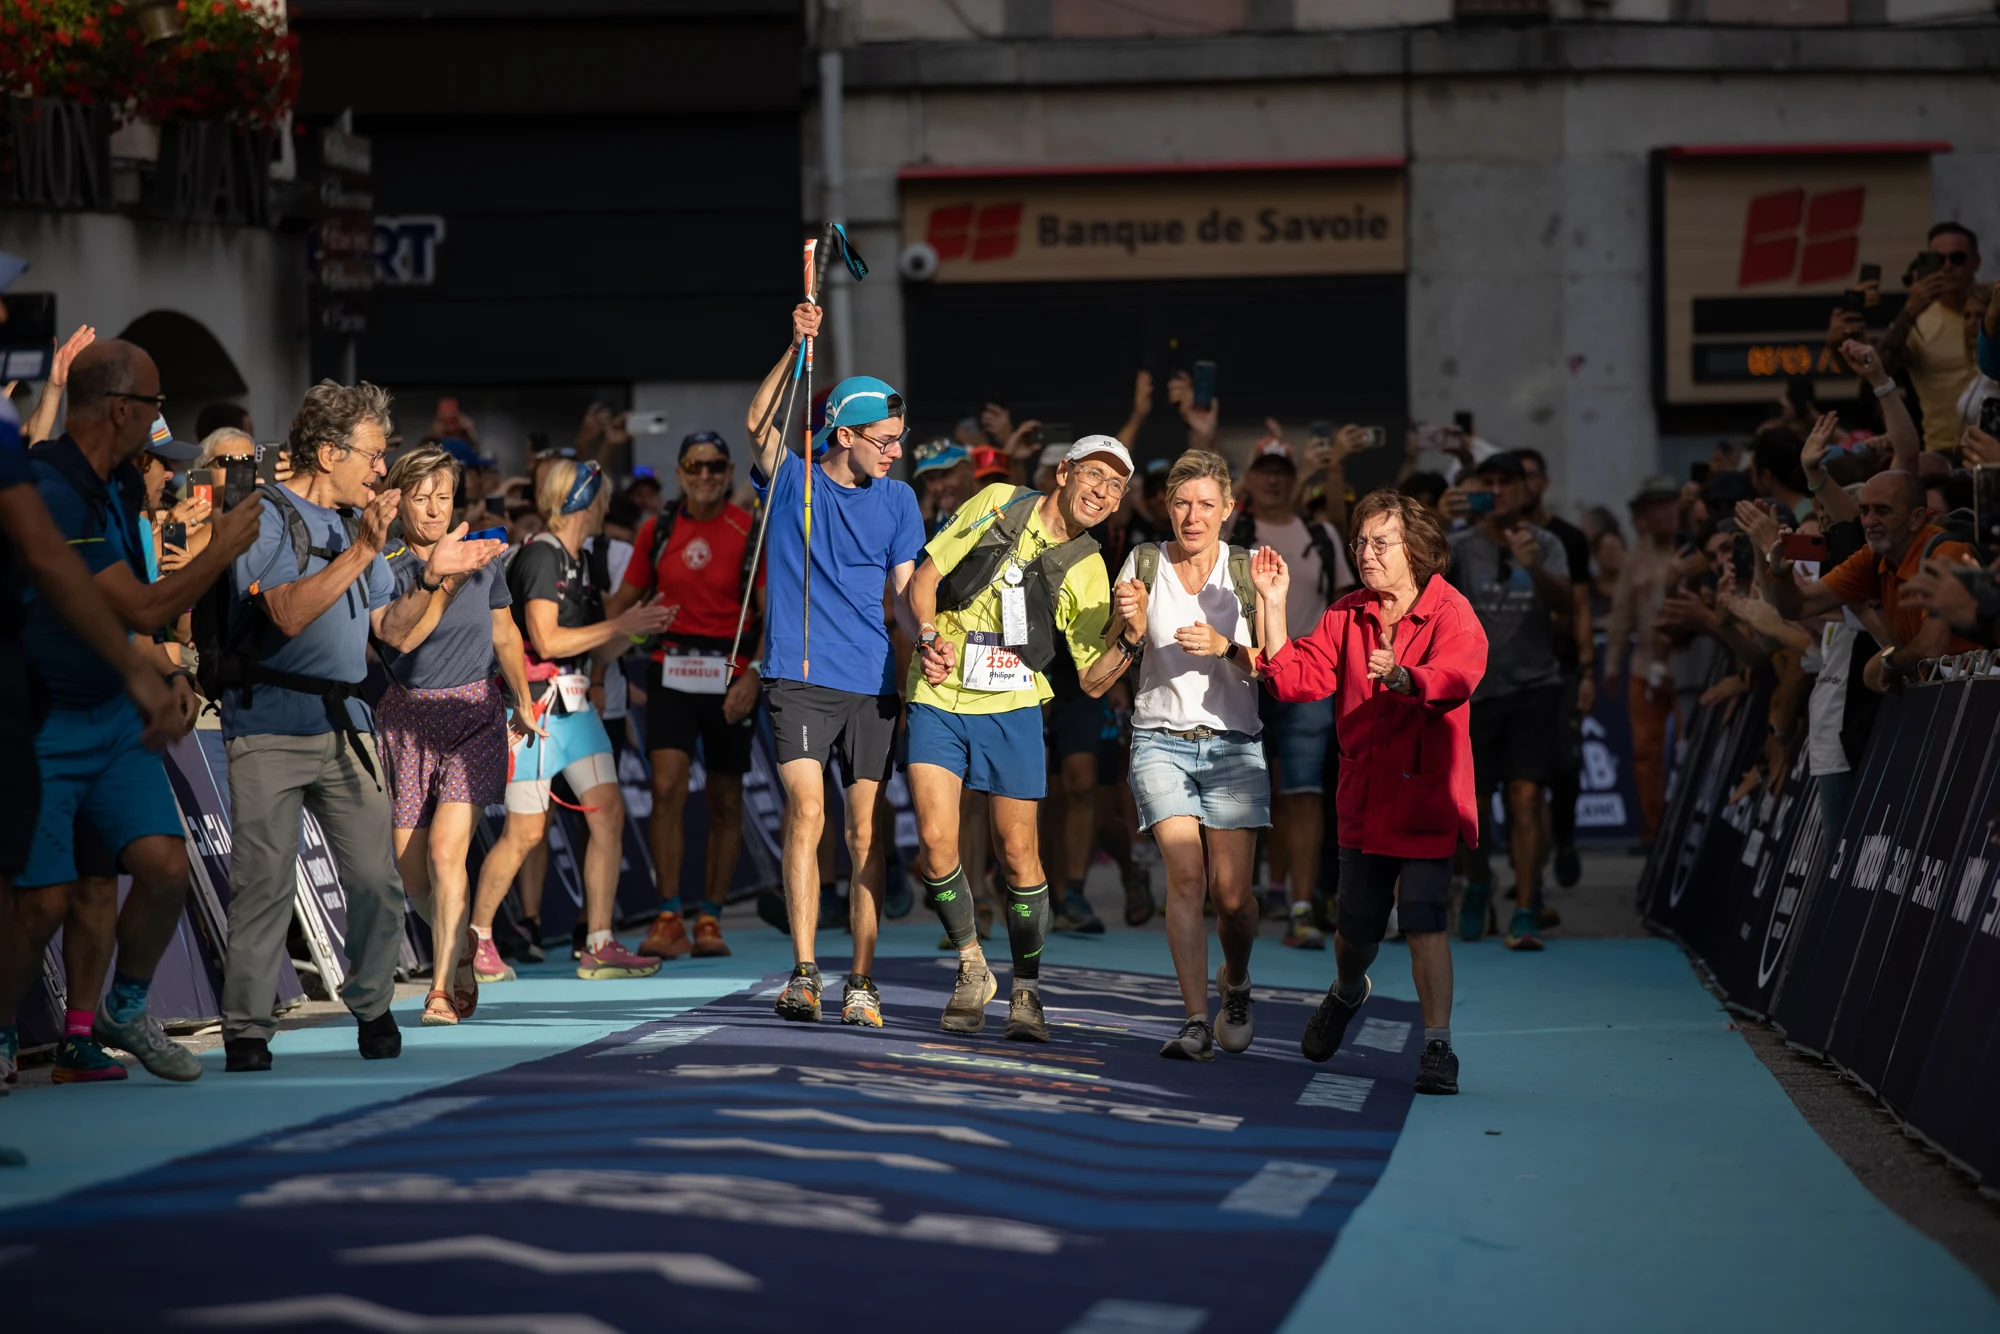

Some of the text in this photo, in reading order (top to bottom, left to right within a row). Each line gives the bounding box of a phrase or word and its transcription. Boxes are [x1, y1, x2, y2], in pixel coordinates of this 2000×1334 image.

[1038, 201, 1387, 254] Banque de Savoie
[985, 655, 1021, 669] 2569
[668, 667, 721, 679] FERMEUR
[989, 671, 1016, 680] Philippe
